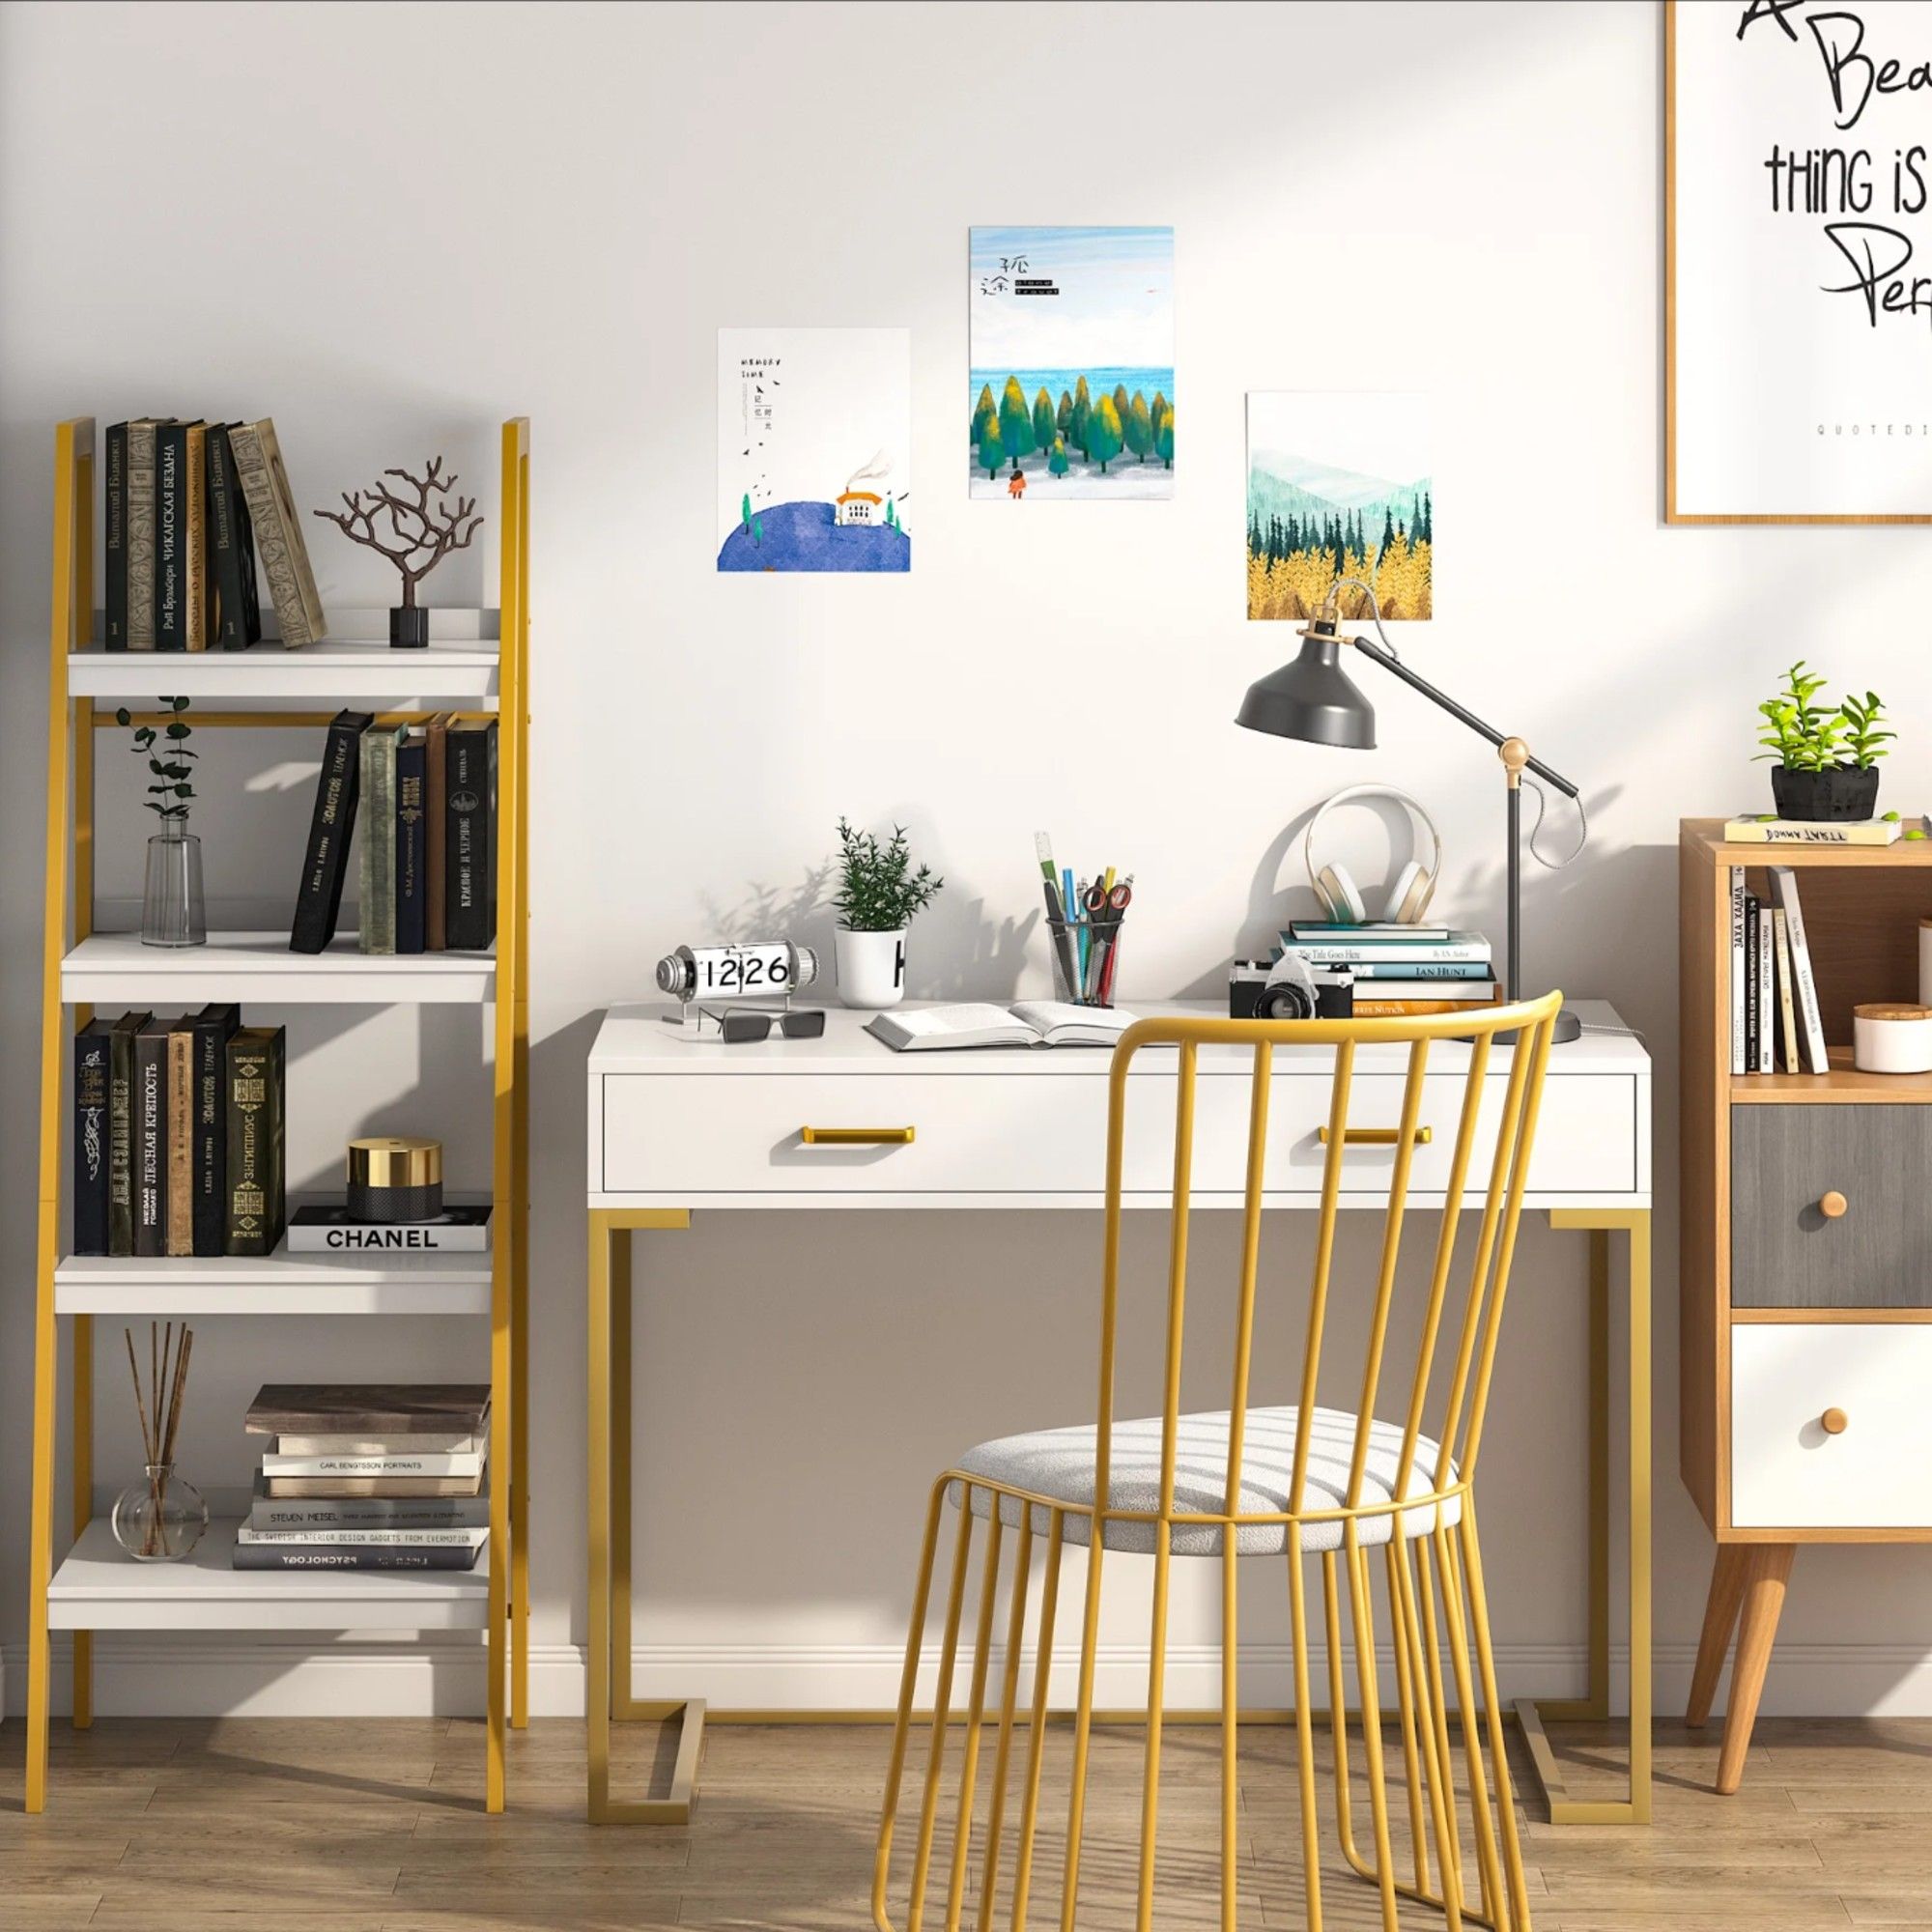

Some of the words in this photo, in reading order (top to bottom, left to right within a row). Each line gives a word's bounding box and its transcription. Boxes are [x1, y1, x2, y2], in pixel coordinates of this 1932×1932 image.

[1818, 221, 1932, 330] Per
[109, 439, 121, 487] Бианки
[163, 443, 175, 488] БЕЗДНА
[162, 489, 175, 560] ЧИКАГСКАЯ
[111, 621, 119, 635] 1
[227, 621, 235, 635] 1
[1734, 886, 1744, 919] ХАДИД
[1734, 924, 1744, 949] ЗАХА
[1416, 967, 1435, 976] IAN
[1437, 967, 1466, 976] HUNT
[145, 1064, 157, 1127] КРЕПОСТЬ
[145, 1132, 157, 1183] ЛЕСНАЯ
[327, 1230, 439, 1248] CHANEL
[320, 1462, 338, 1470] CARL
[384, 1462, 422, 1470] PORTRAITS
[270, 1513, 303, 1522] STEVEN
[308, 1513, 337, 1522] MEISEL
[339, 1533, 366, 1543] DESIGN
[405, 1534, 423, 1543] FROM
